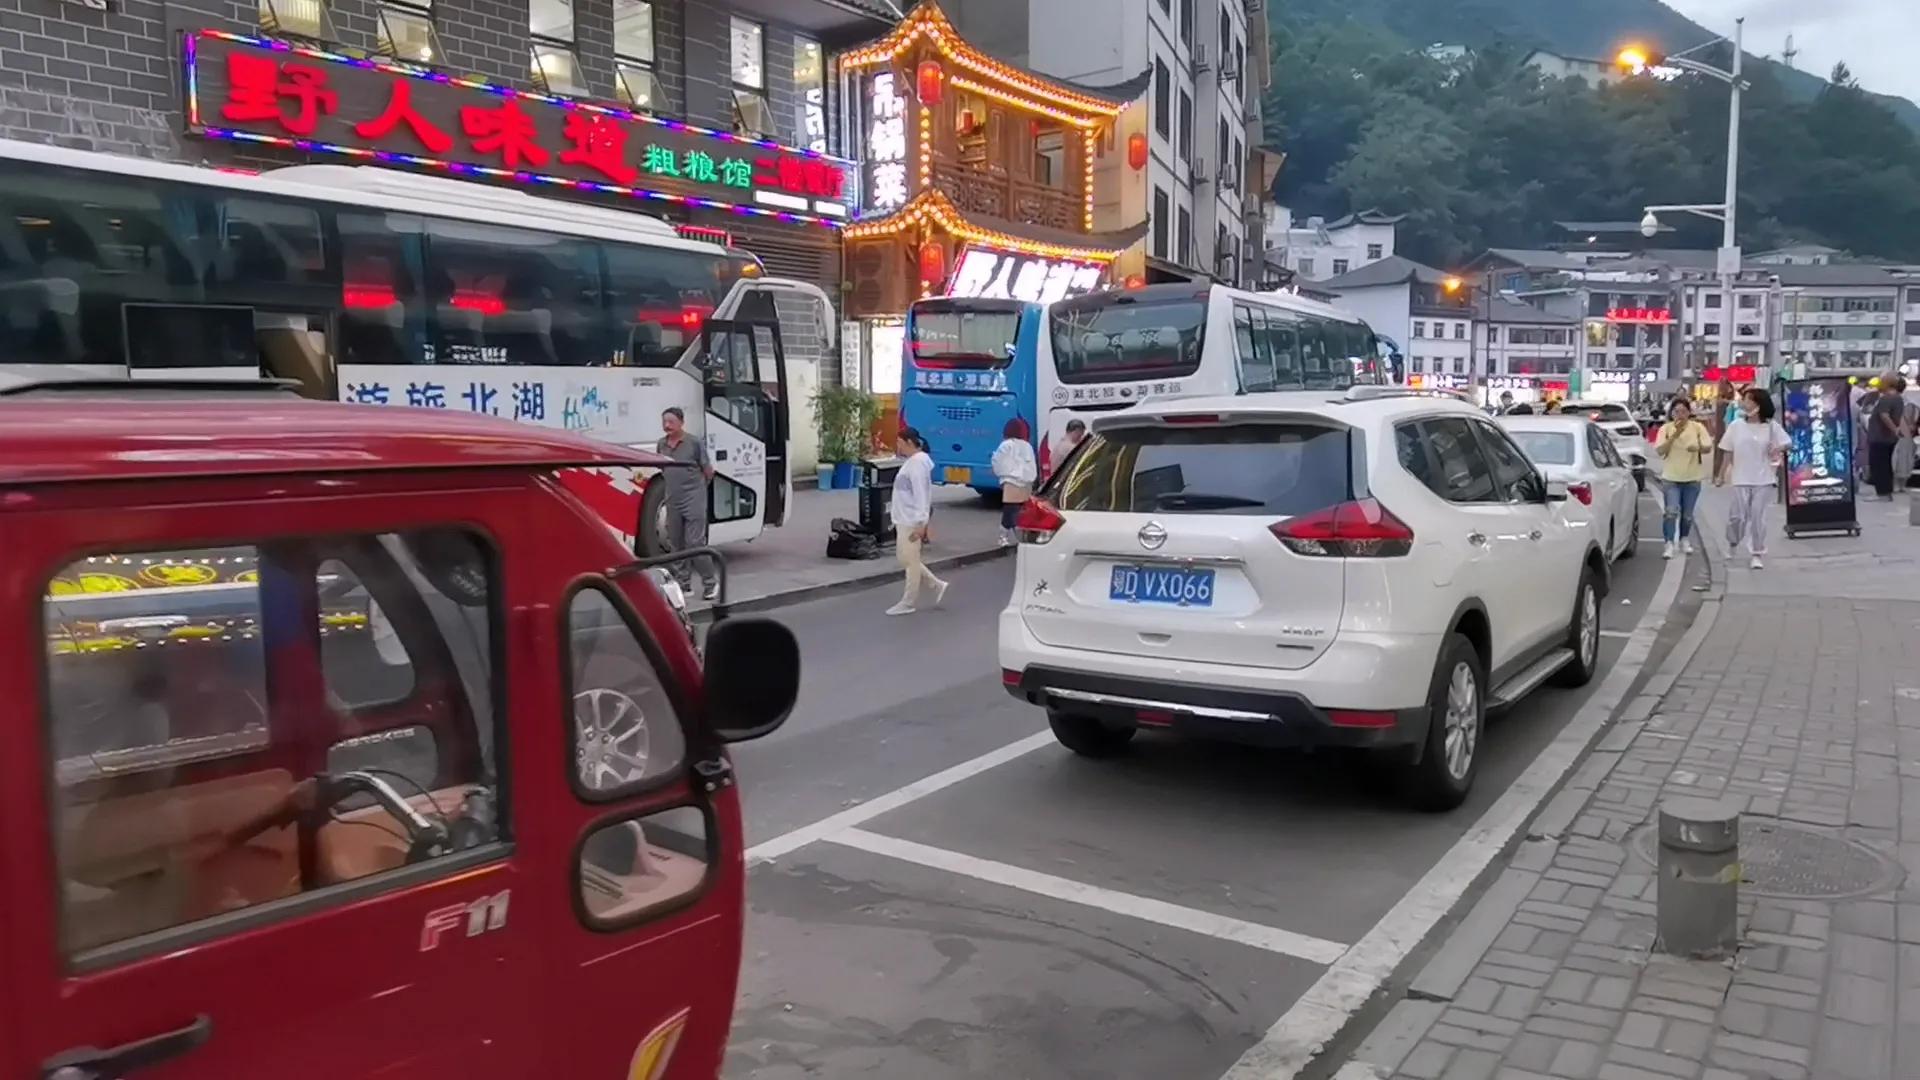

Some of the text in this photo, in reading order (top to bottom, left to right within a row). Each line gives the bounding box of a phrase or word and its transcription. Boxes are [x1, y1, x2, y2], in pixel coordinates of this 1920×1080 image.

[224, 54, 639, 184] 野人味道
[641, 145, 752, 187] 粗粮馆
[419, 889, 511, 952] F11
